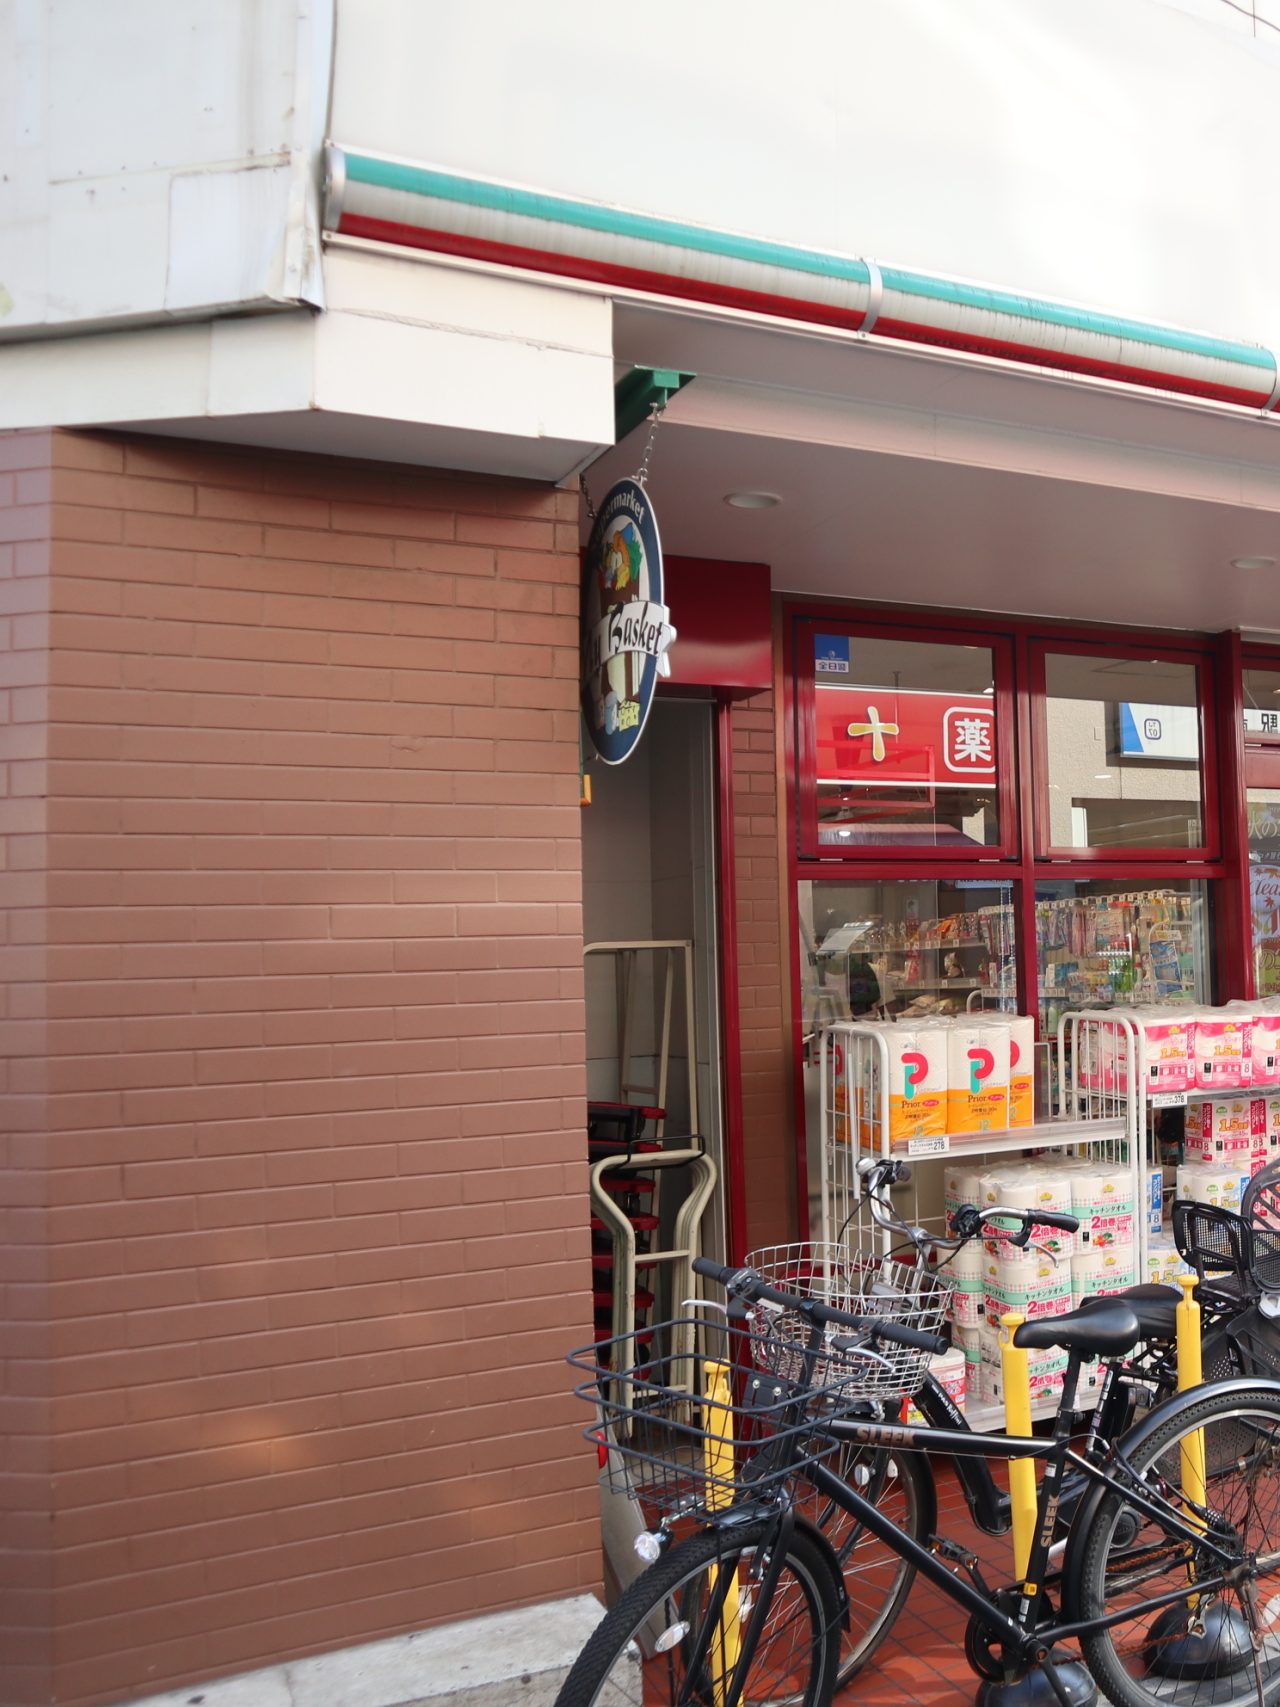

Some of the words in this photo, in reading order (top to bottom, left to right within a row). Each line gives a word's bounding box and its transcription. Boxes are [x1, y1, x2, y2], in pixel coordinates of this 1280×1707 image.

[609, 602, 662, 656] Basket
[901, 1099, 921, 1109] Prior
[968, 1094, 986, 1103] Prior
[933, 1141, 945, 1151] 278
[1090, 1204, 1126, 1215] キッチンタオル
[1092, 1276, 1128, 1289] キッチンタオル
[1025, 1287, 1064, 1300] キッチンタオル
[1029, 1360, 1062, 1373] ッチンタオル
[856, 1426, 915, 1447] SLEEK
[1040, 1495, 1060, 1548] SLEEK
